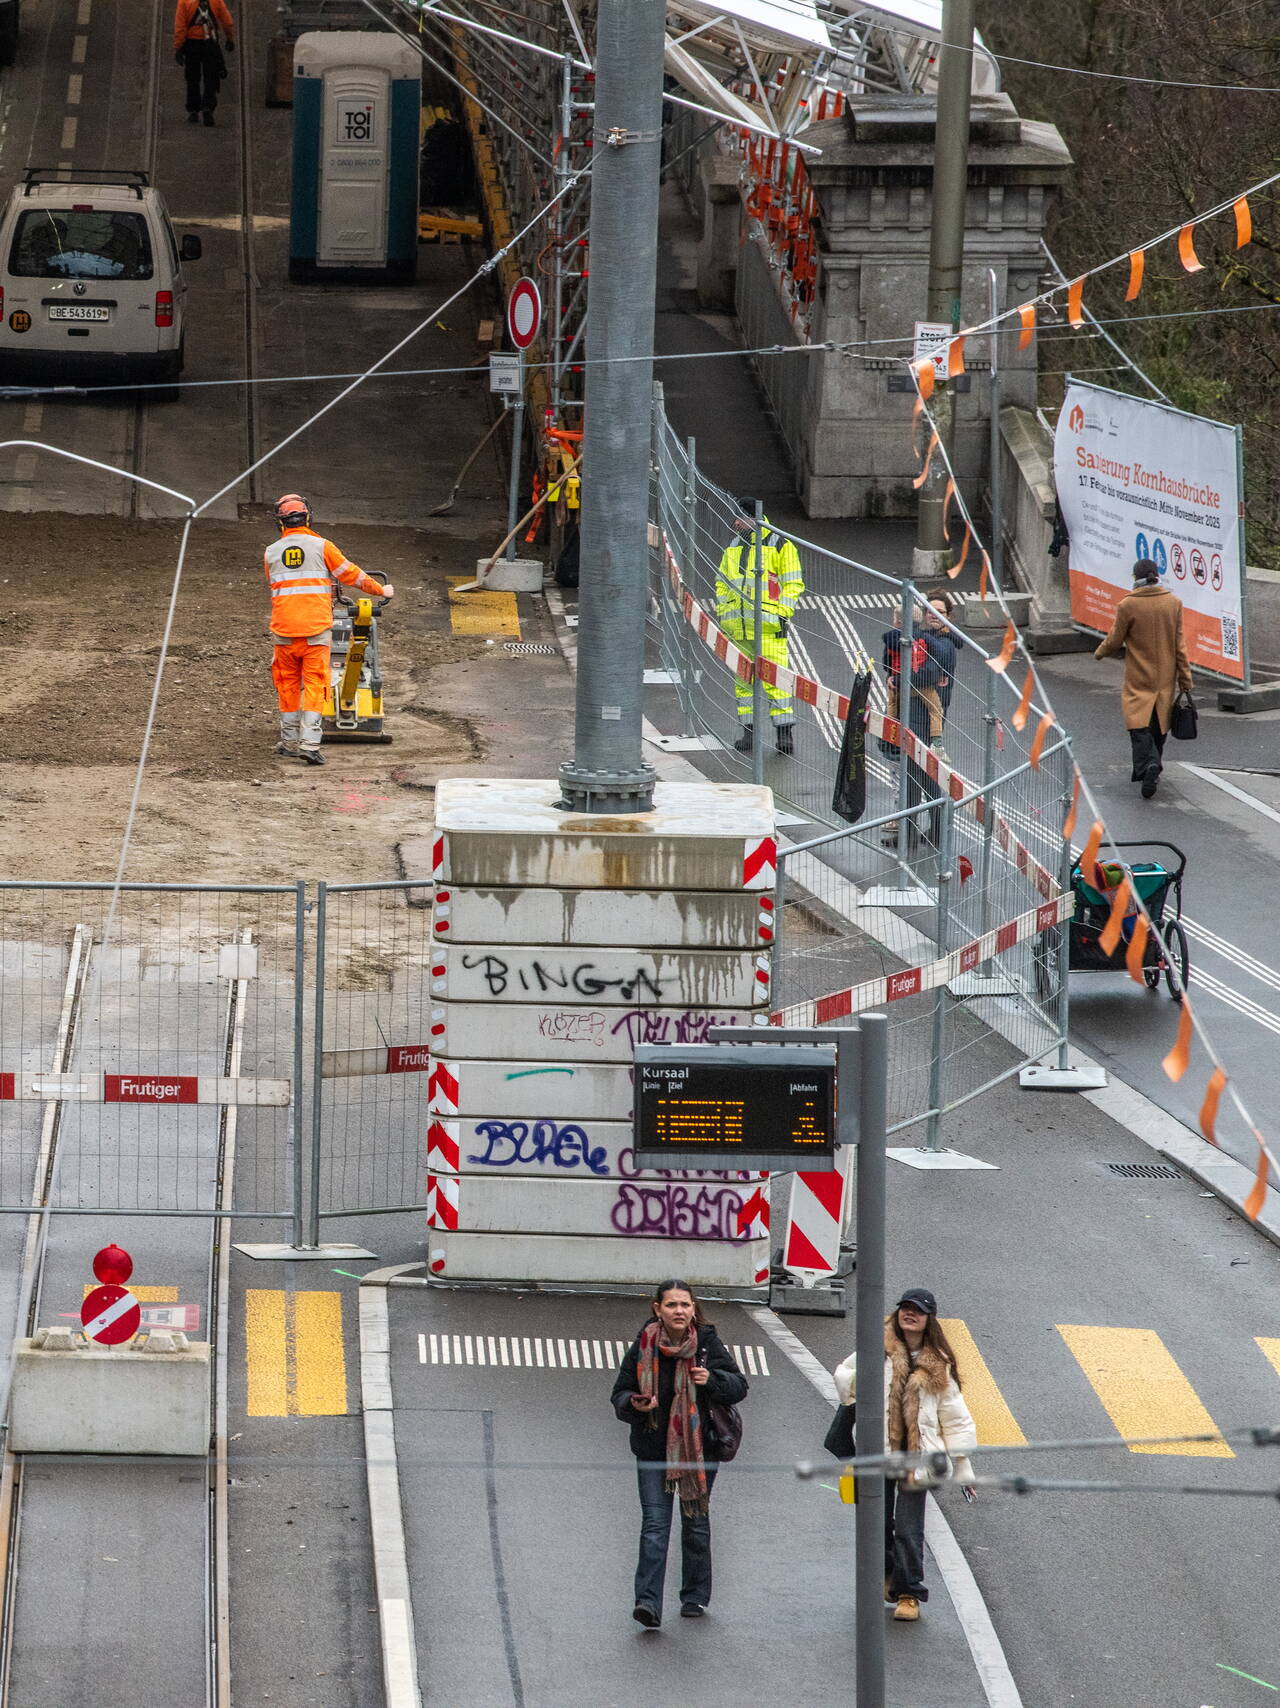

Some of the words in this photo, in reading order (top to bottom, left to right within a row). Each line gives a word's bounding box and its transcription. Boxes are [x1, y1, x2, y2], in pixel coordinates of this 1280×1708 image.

[345, 112, 371, 126] TOI
[344, 126, 370, 140] TOI
[1174, 504, 1204, 525] November
[1205, 514, 1221, 529] 2025
[398, 1051, 430, 1067] Frutig
[642, 1067, 689, 1079] Kursaal
[120, 1079, 181, 1100] Frutiger
[645, 1082, 661, 1090] Linie
[670, 1082, 683, 1090] Ziel
[792, 1083, 818, 1092] Abfahrt
